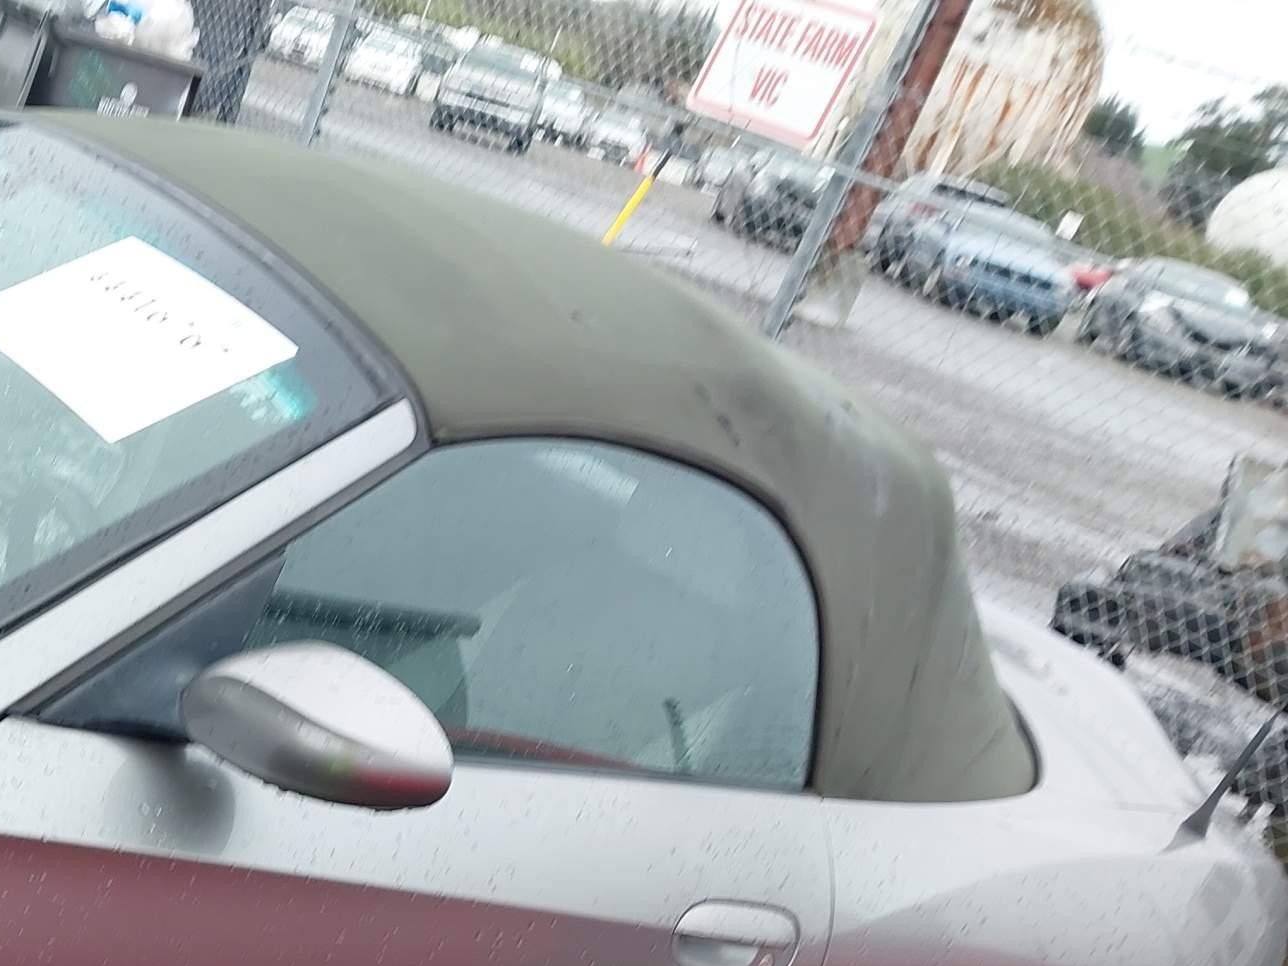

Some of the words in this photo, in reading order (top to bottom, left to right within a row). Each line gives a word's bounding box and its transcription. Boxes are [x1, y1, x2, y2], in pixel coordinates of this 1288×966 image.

[735, 2, 801, 52] STATE
[792, 19, 861, 70] FARM
[749, 62, 789, 106] VIC
